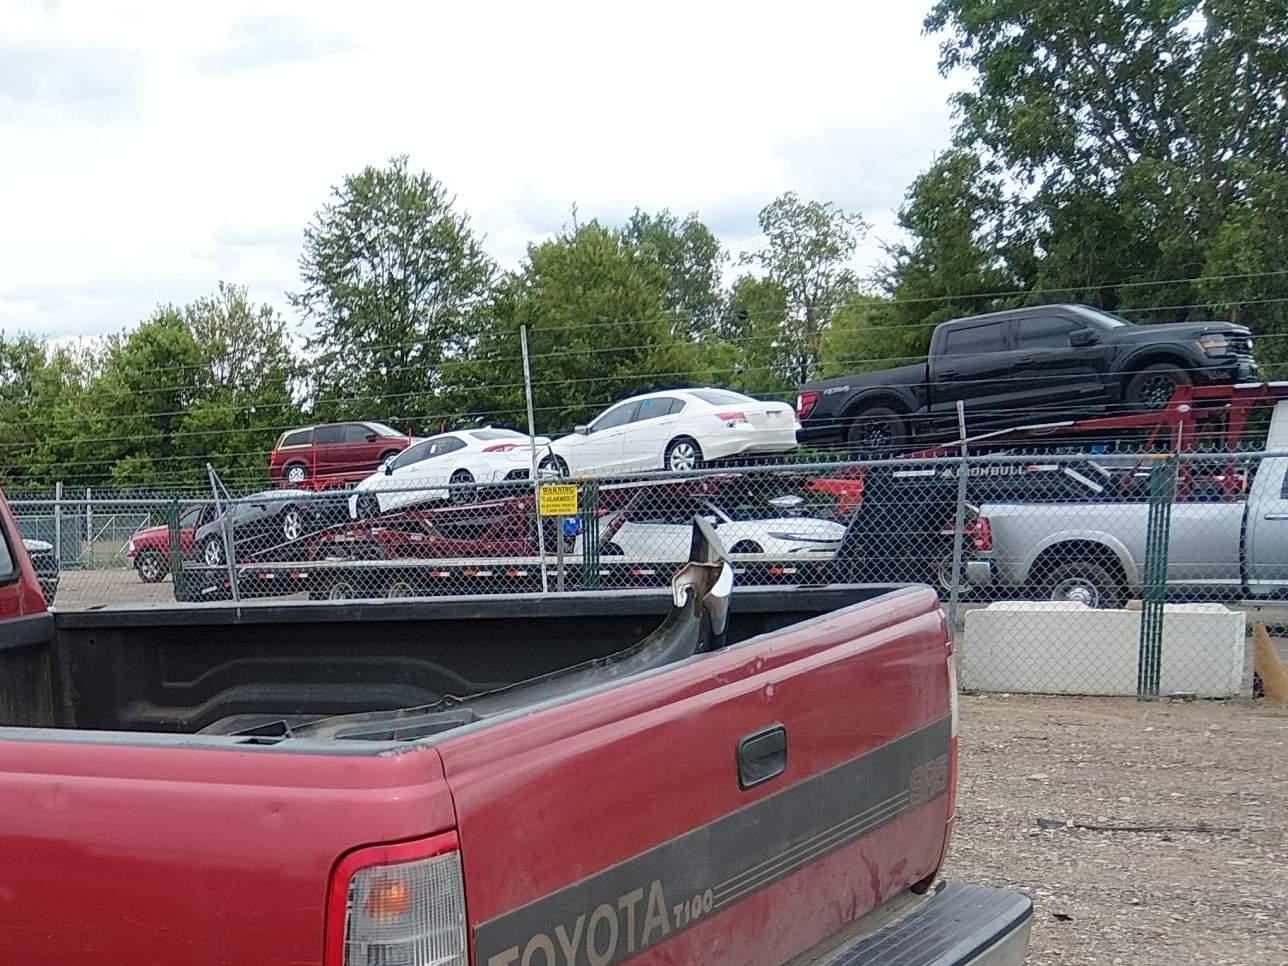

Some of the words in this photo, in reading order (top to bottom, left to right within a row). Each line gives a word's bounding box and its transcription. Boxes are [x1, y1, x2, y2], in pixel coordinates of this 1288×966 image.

[956, 465, 1025, 478] IONBULL
[542, 486, 575, 495] WARNING
[909, 753, 948, 804] SR5
[672, 888, 714, 931] T100
